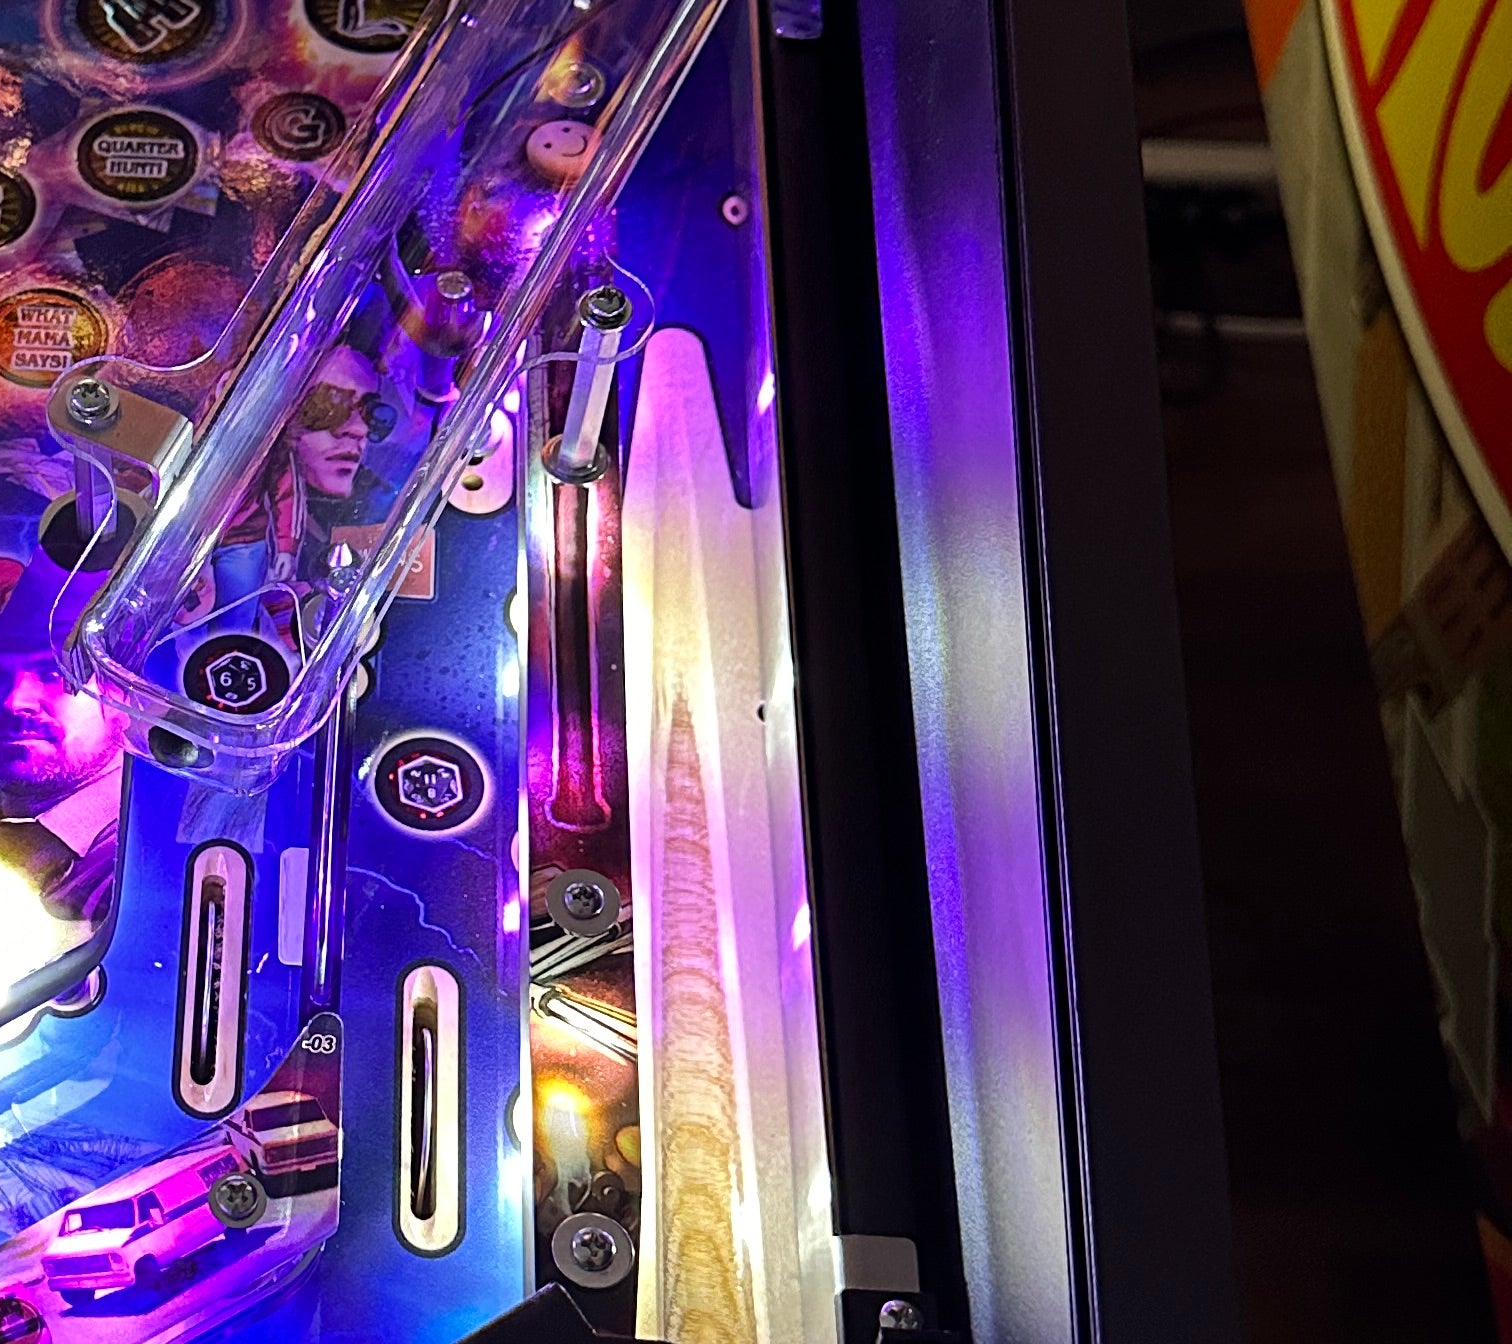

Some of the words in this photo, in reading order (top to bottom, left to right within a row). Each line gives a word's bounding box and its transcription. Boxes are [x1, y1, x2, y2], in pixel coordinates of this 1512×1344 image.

[96, 138, 181, 156] QUARTER
[19, 309, 76, 326] WHAT
[15, 329, 71, 347] MAMA
[13, 352, 69, 370] SAYS!
[302, 1034, 336, 1053] -03
